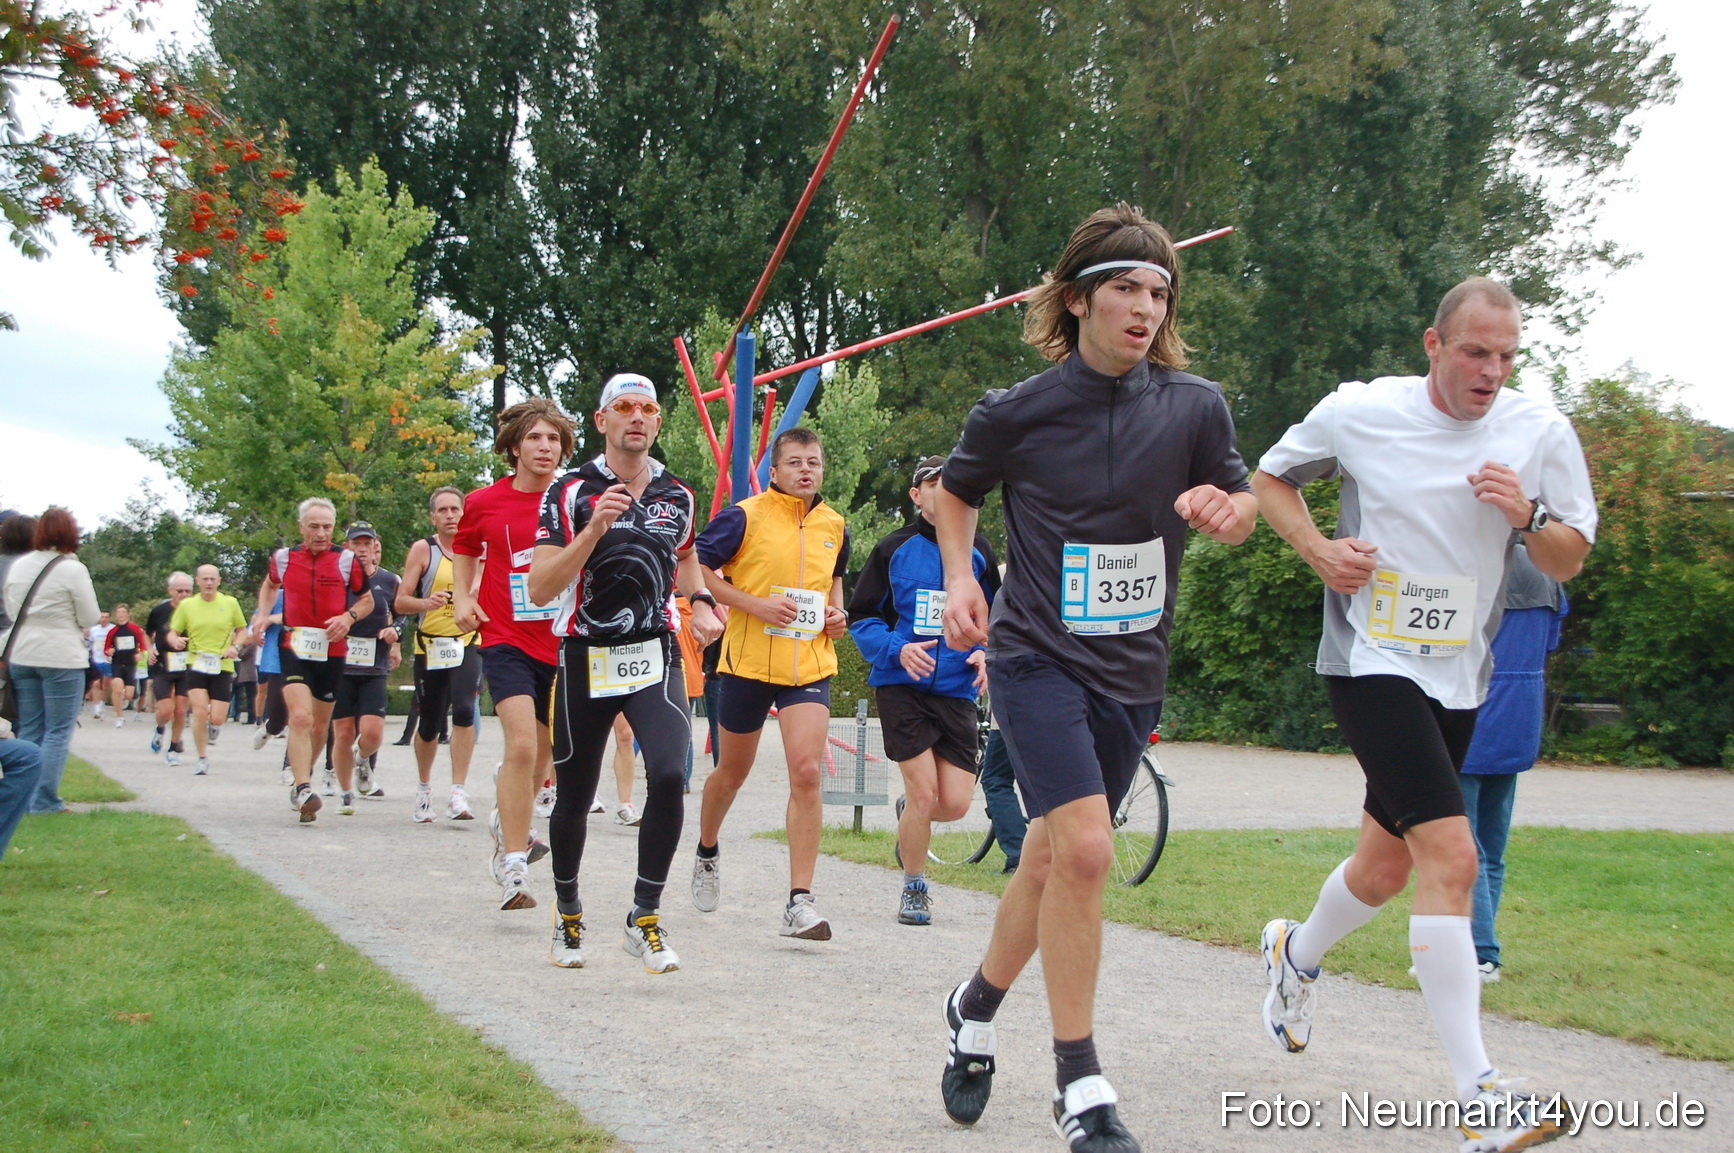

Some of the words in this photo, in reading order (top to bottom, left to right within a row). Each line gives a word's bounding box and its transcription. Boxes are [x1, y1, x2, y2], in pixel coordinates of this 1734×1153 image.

[1097, 553, 1137, 570] Daniel
[1071, 579, 1078, 591] B
[1098, 575, 1157, 603] 3357
[1401, 582, 1449, 601] Jürgen
[1375, 599, 1383, 612] B
[792, 609, 817, 625] 33
[1407, 607, 1457, 630] 267
[304, 639, 322, 651] 701
[351, 646, 369, 656] 273
[440, 648, 458, 659] 903
[617, 660, 651, 678] 662
